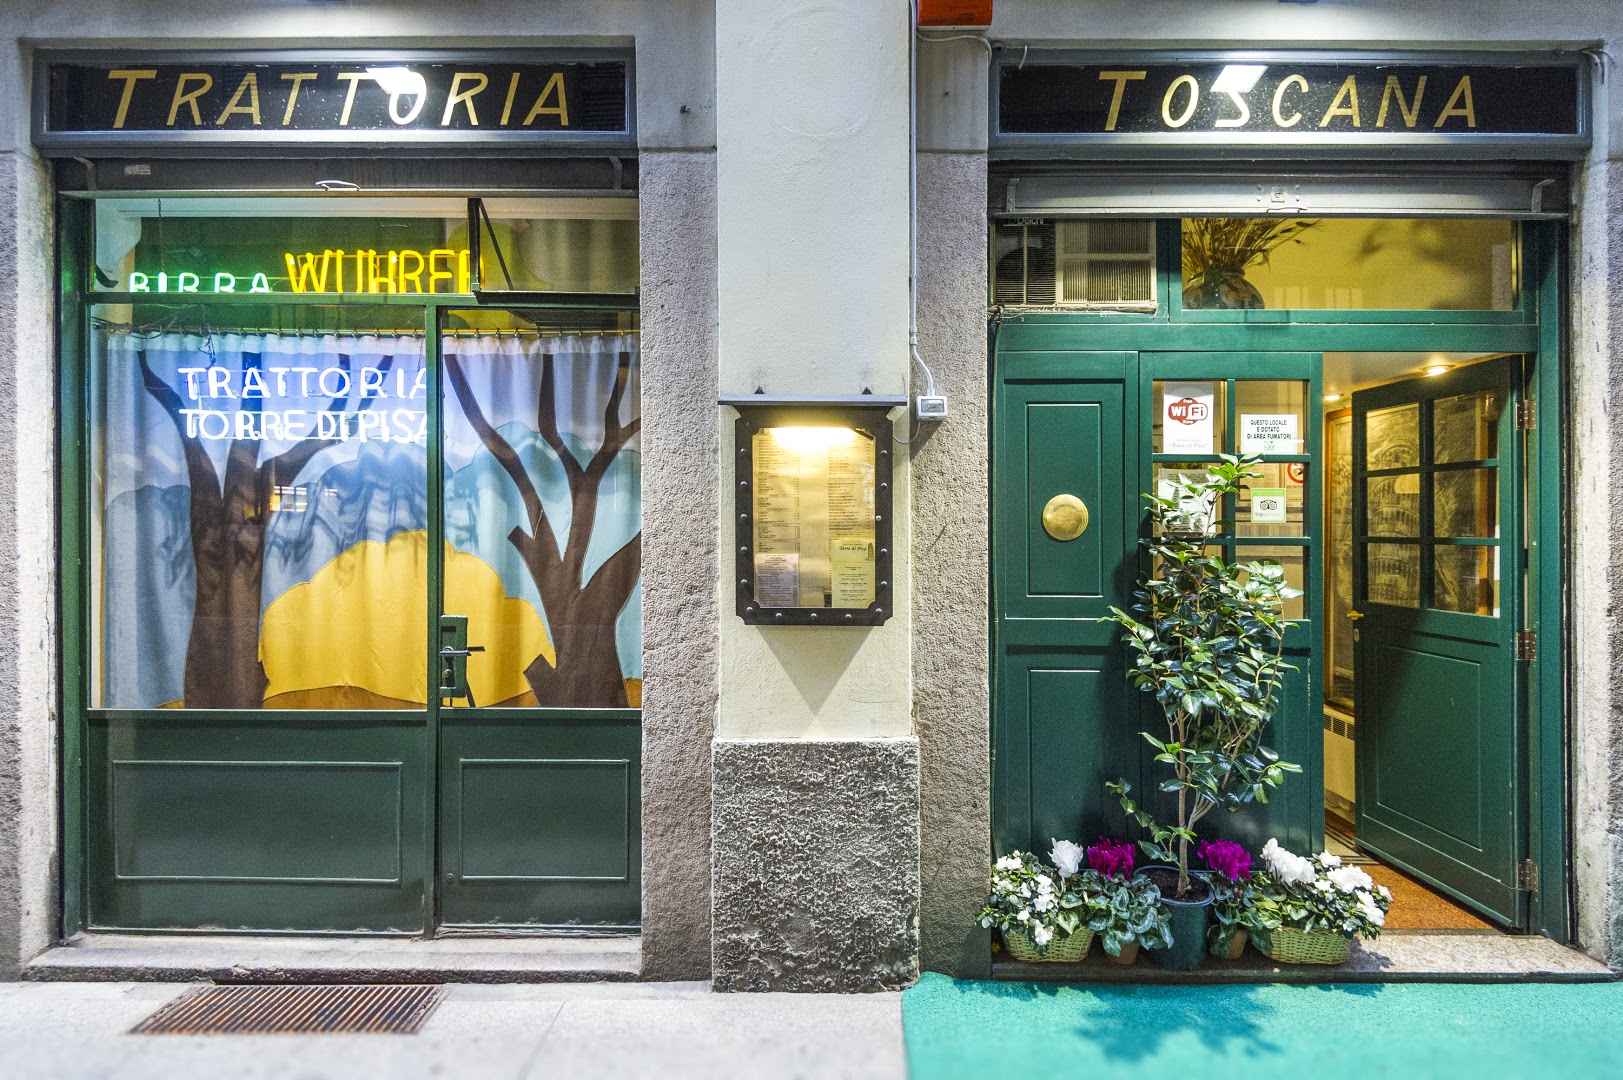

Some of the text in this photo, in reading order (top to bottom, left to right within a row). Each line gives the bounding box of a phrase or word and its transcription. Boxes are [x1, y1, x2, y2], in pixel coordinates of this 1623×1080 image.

[108, 69, 569, 129] TRATTORIA
[1098, 70, 1477, 131] TOSCANA
[129, 272, 270, 293] BIRRA
[178, 408, 306, 441] TORRE
[317, 410, 350, 442] DI
